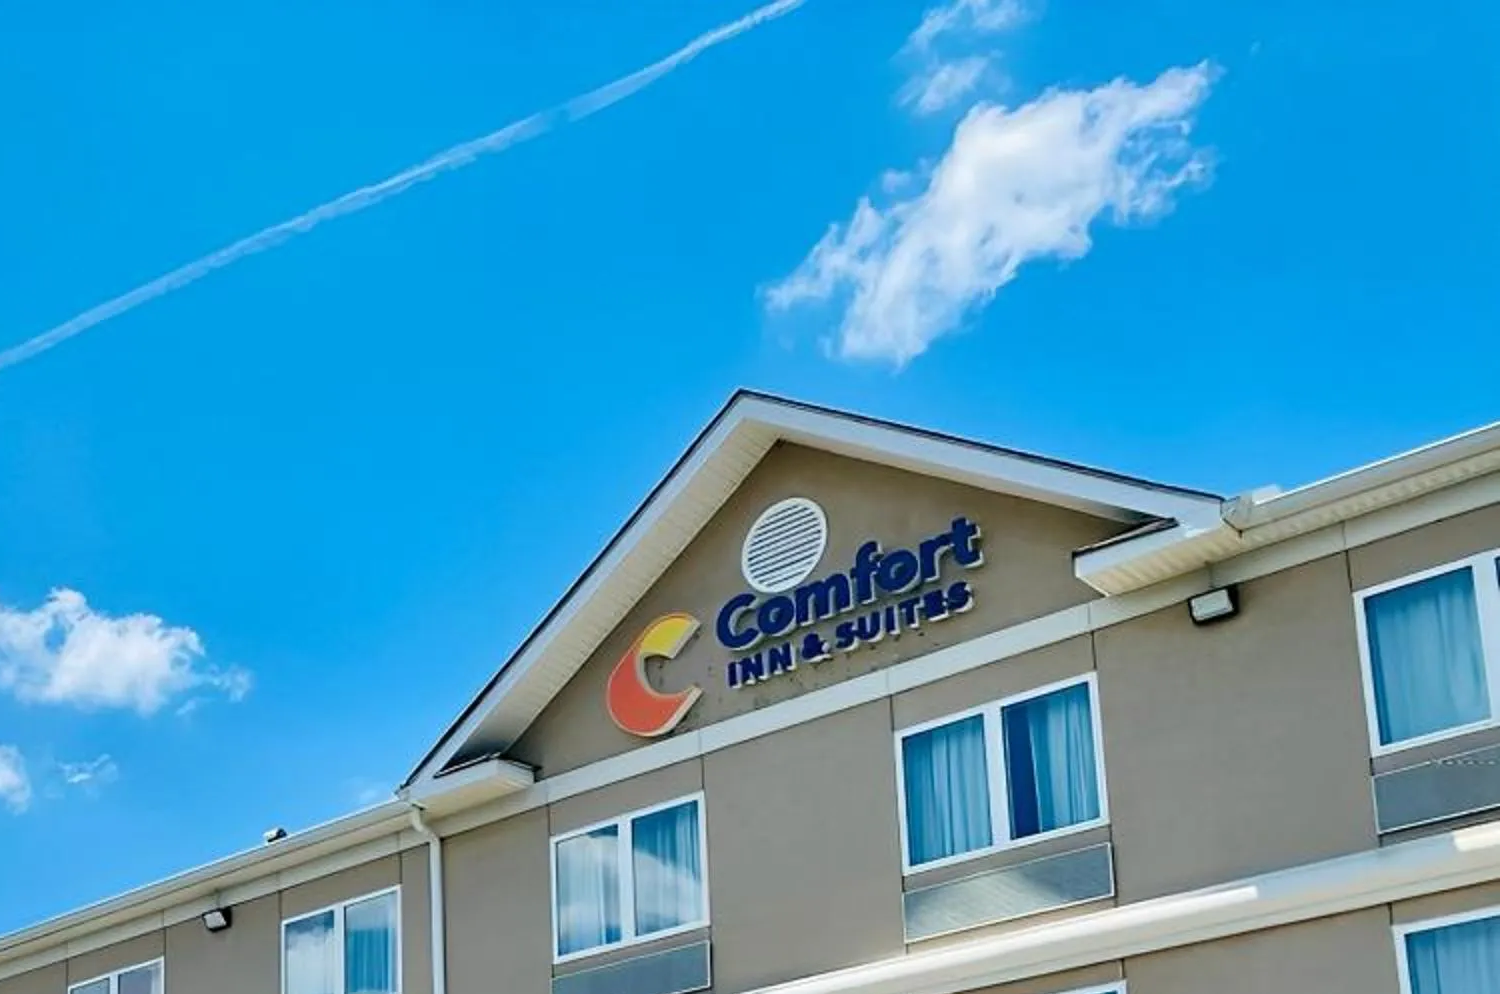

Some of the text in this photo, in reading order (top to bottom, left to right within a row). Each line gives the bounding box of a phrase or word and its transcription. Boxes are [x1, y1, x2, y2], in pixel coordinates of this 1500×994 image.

[715, 517, 983, 650] Comfort
[727, 581, 974, 688] INN & SUITES
